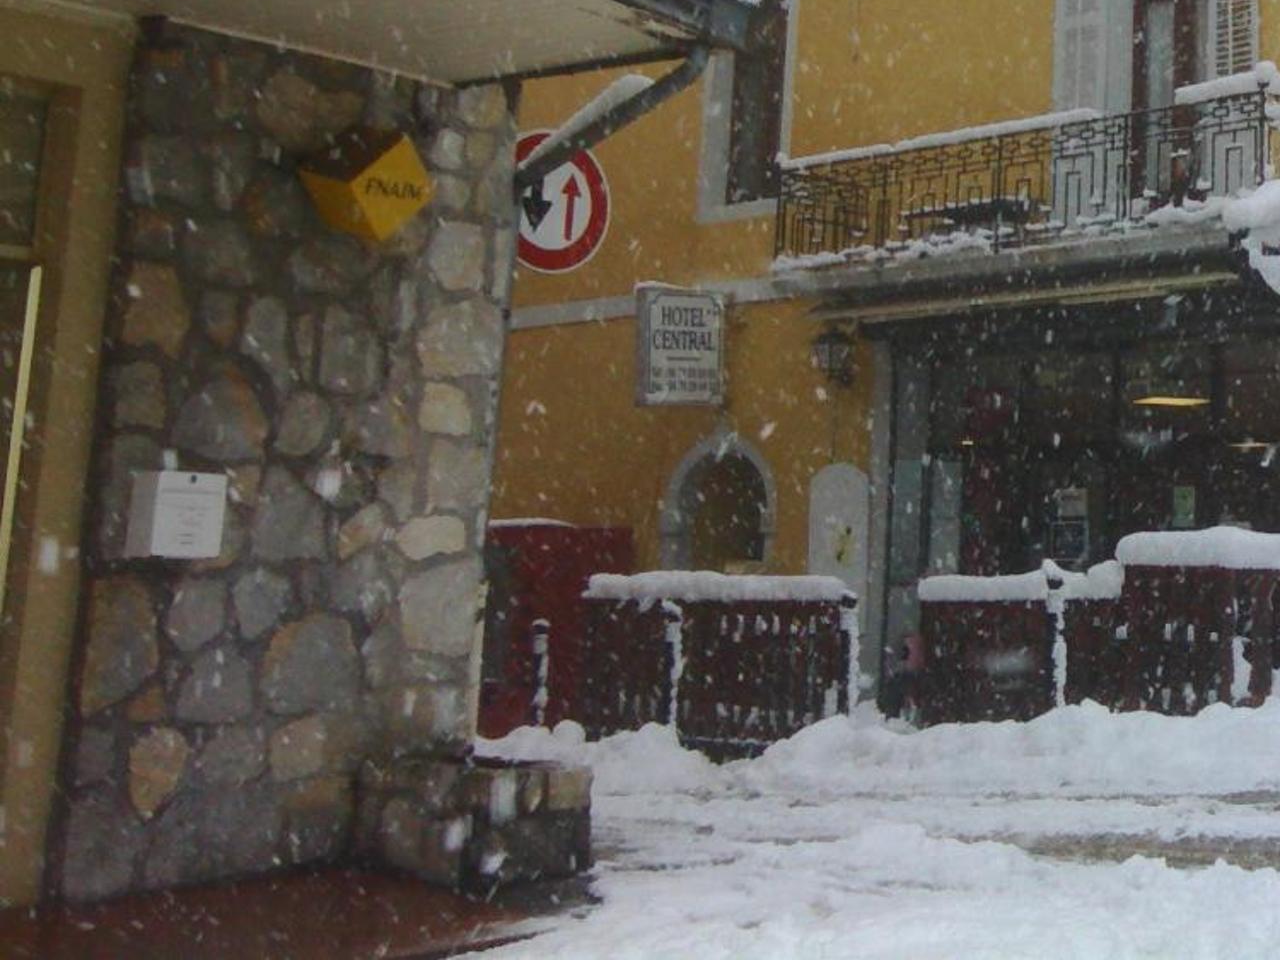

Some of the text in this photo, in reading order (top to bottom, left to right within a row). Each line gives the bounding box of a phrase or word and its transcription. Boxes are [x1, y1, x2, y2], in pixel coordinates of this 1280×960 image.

[364, 177, 423, 201] FNAIM
[661, 305, 707, 328] HOTEL
[653, 328, 716, 352] CENTRAL
